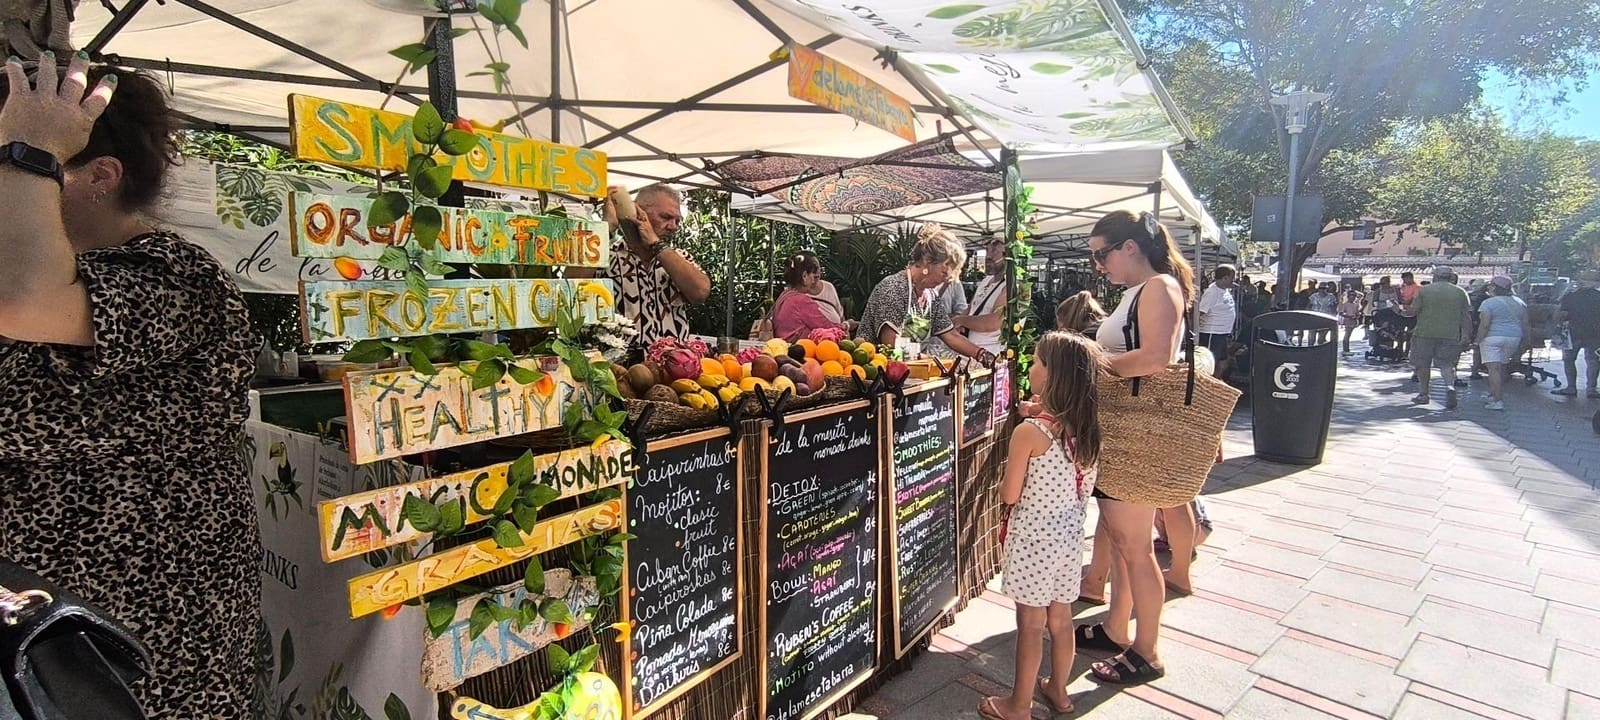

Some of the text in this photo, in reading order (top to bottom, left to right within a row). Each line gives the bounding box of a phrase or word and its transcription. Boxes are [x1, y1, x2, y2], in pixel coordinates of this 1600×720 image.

[315, 103, 600, 193] SMOTHIES
[236, 230, 277, 274] de
[326, 284, 517, 338] FROZEN
[373, 376, 552, 455] HEALTHY
[775, 431, 793, 457] de
[797, 424, 810, 449] la
[533, 450, 633, 493] MONADE
[681, 519, 717, 551] fruit
[637, 557, 681, 592] Cuban
[635, 586, 733, 655] Piña Colada 8€
[822, 596, 854, 627] COFFEE
[635, 641, 687, 679] Pomada
[717, 642, 731, 658] 8€
[817, 634, 847, 662] without
